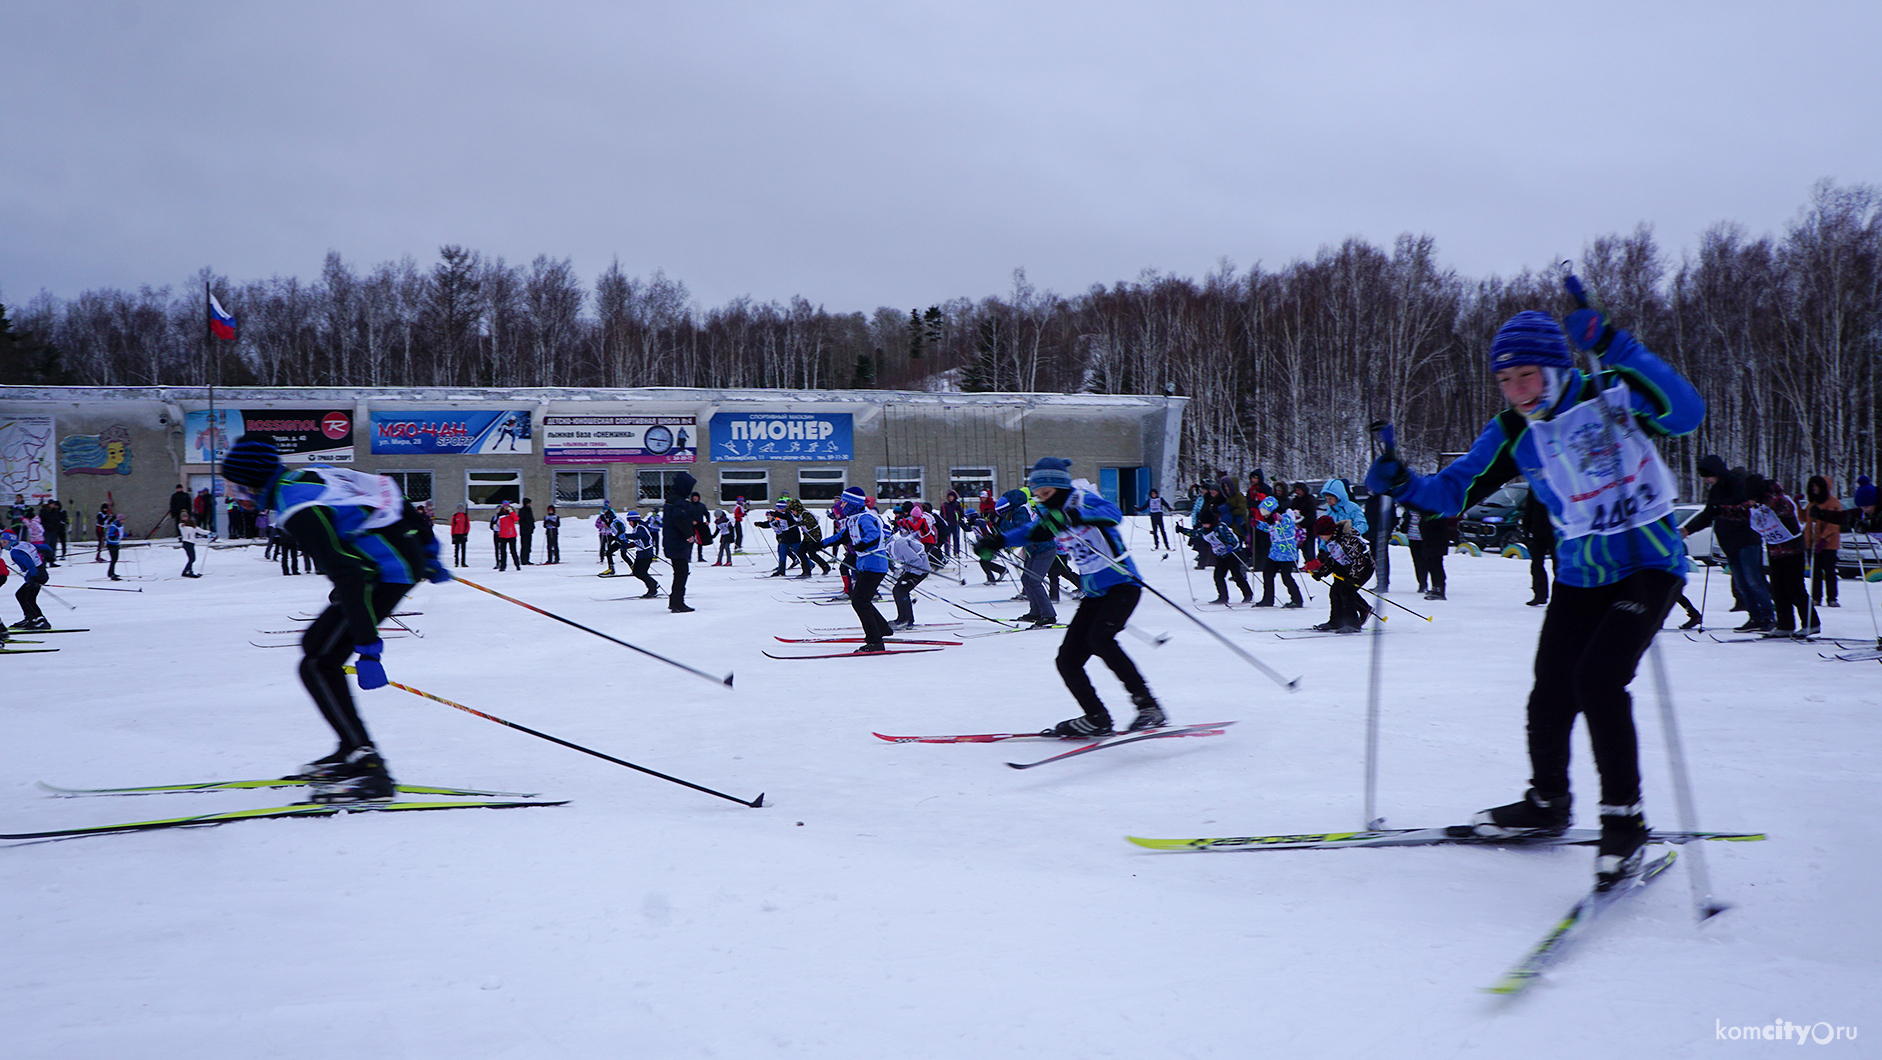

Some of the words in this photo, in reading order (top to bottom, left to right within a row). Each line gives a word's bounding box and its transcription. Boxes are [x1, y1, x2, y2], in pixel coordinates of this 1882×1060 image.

[246, 420, 320, 431] ROSSIGNOL
[377, 422, 468, 438] МЯО-ЧАН
[730, 420, 834, 440] ПИОНЕР
[391, 438, 412, 446] Мира,
[436, 436, 475, 447] SPORT
